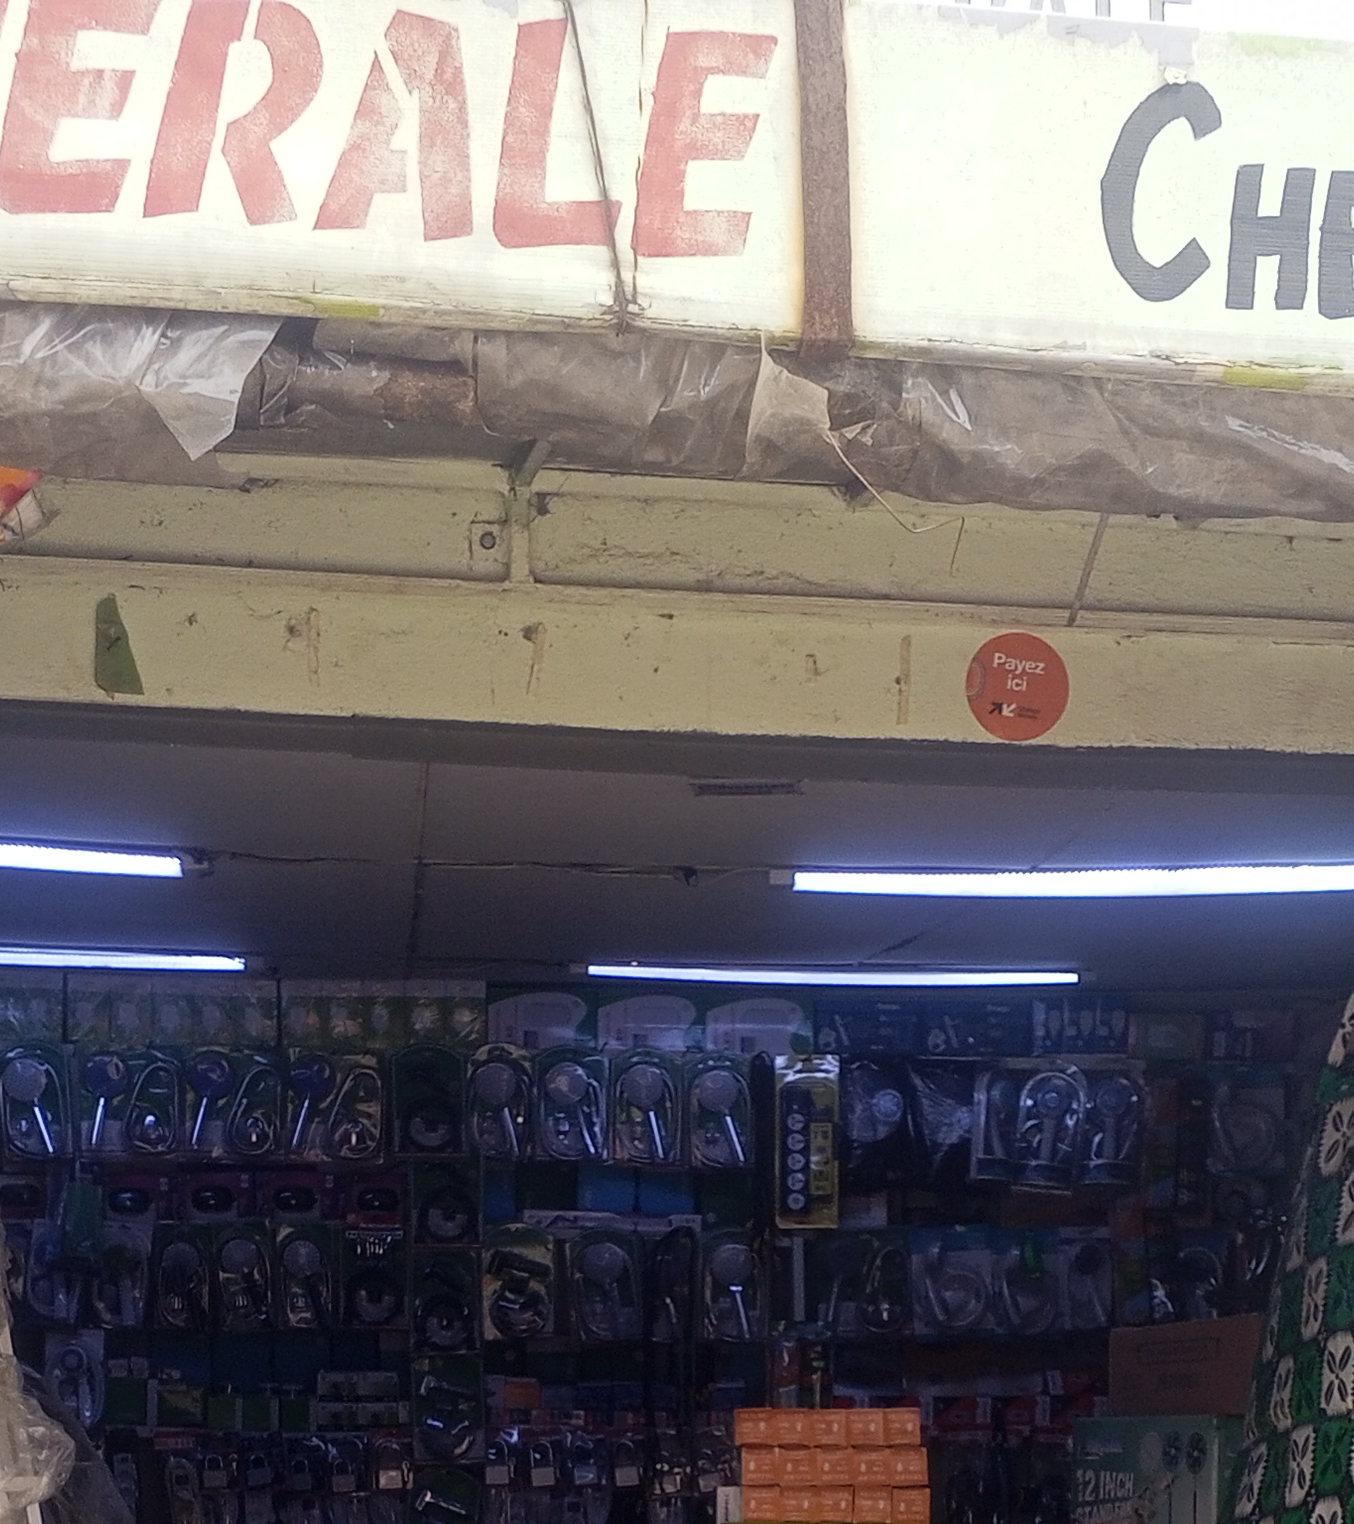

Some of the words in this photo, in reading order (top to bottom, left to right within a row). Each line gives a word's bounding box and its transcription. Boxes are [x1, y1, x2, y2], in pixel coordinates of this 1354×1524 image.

[993, 652, 1045, 675] Payez
[1006, 673, 1027, 692] ici
[1100, 1473, 1135, 1499] INCH
